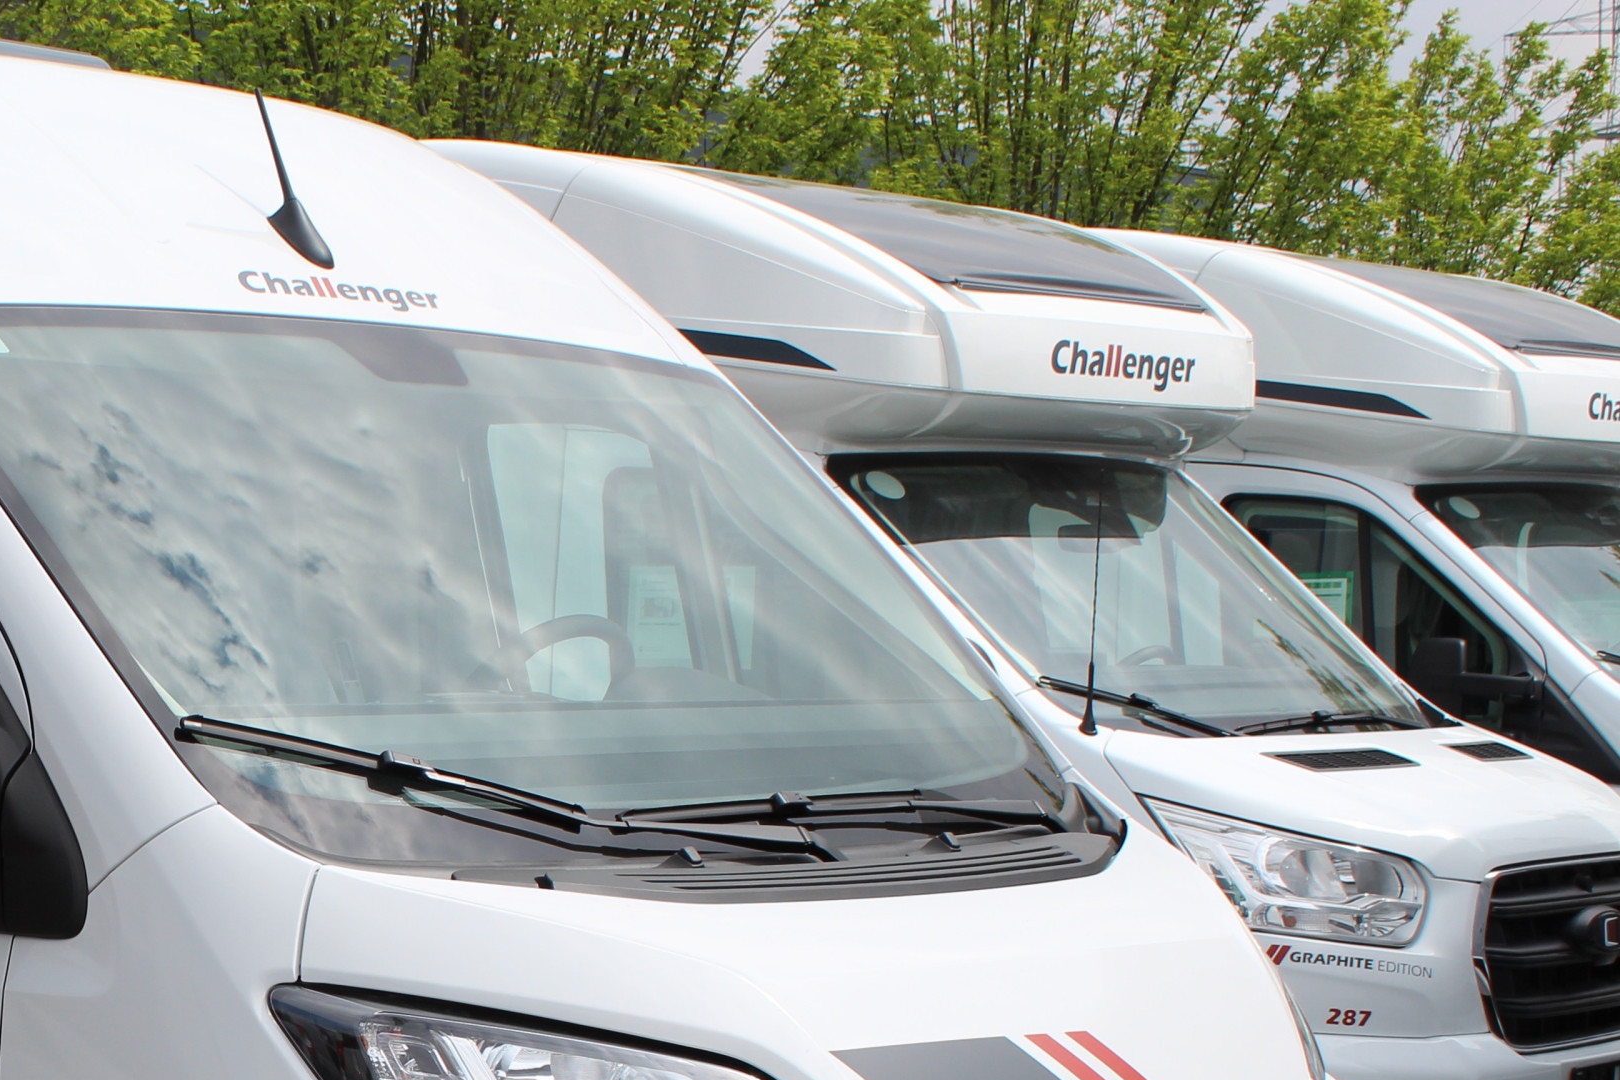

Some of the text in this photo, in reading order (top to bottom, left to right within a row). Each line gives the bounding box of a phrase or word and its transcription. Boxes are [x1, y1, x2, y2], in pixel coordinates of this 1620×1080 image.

[238, 270, 438, 312] Challenger
[1051, 339, 1195, 392] Challenger
[1290, 951, 1433, 978] GRAPHITE EDITION
[1326, 1008, 1372, 1027] 287
